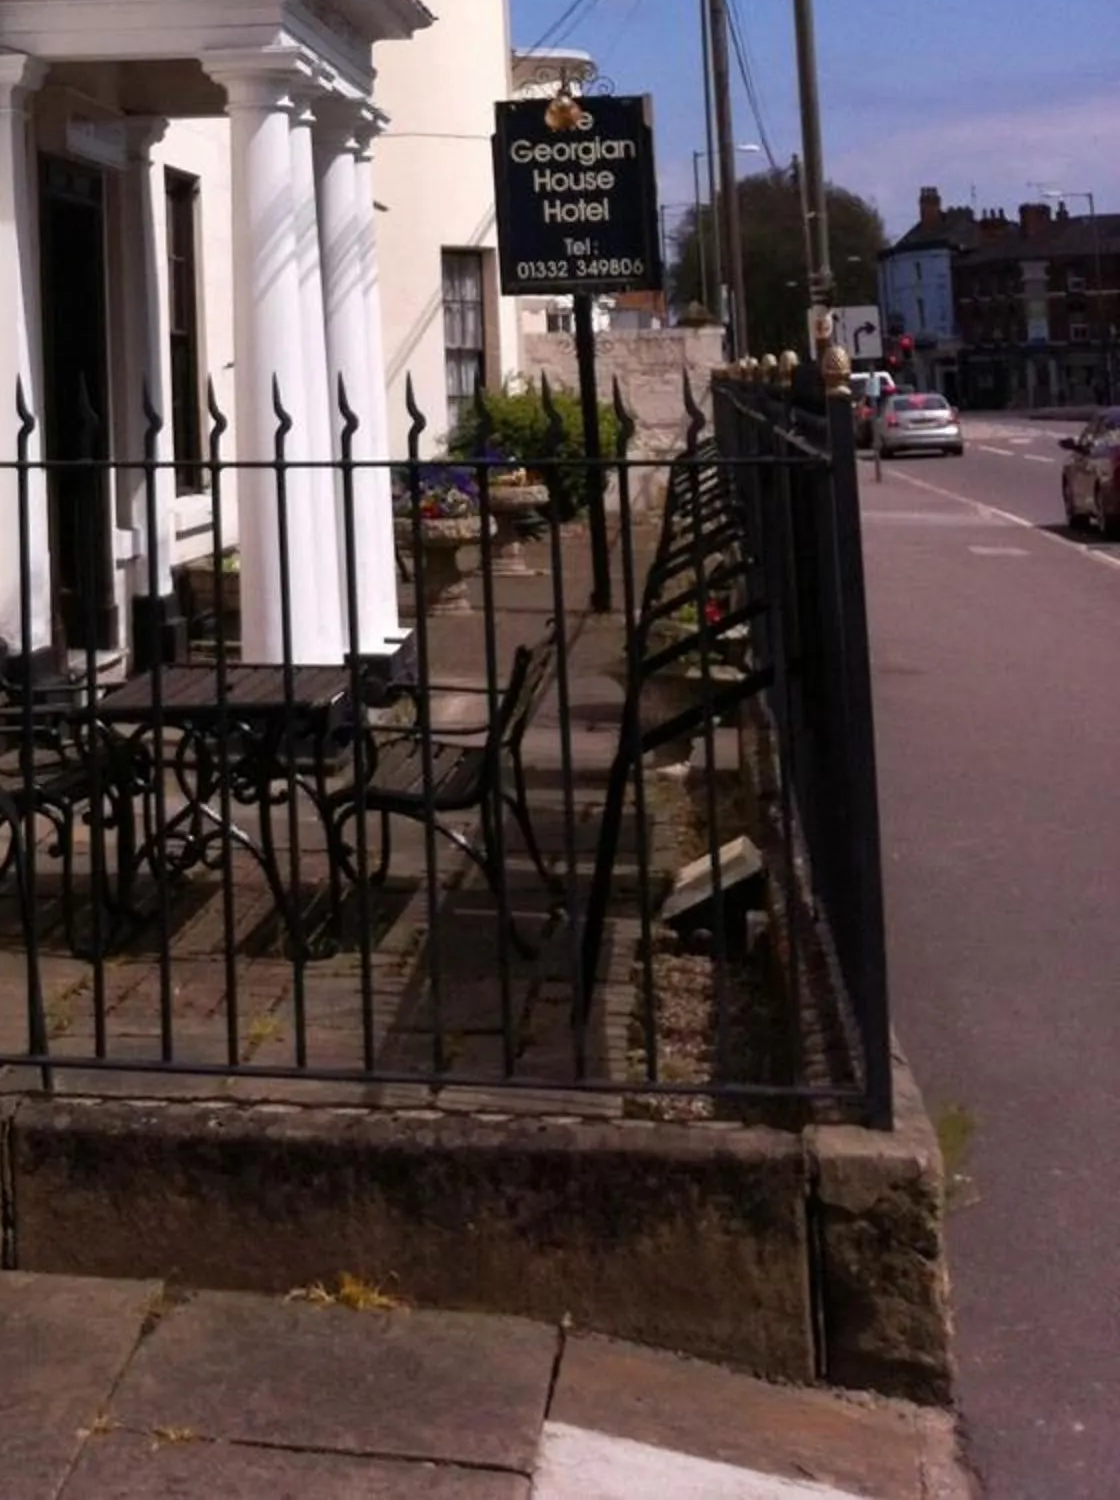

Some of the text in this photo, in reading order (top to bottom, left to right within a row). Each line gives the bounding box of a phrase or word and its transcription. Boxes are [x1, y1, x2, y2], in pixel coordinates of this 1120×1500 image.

[510, 136, 636, 166] Georgian
[533, 169, 615, 193] House
[543, 198, 610, 223] Hotel
[517, 258, 644, 279] 01332 349806
